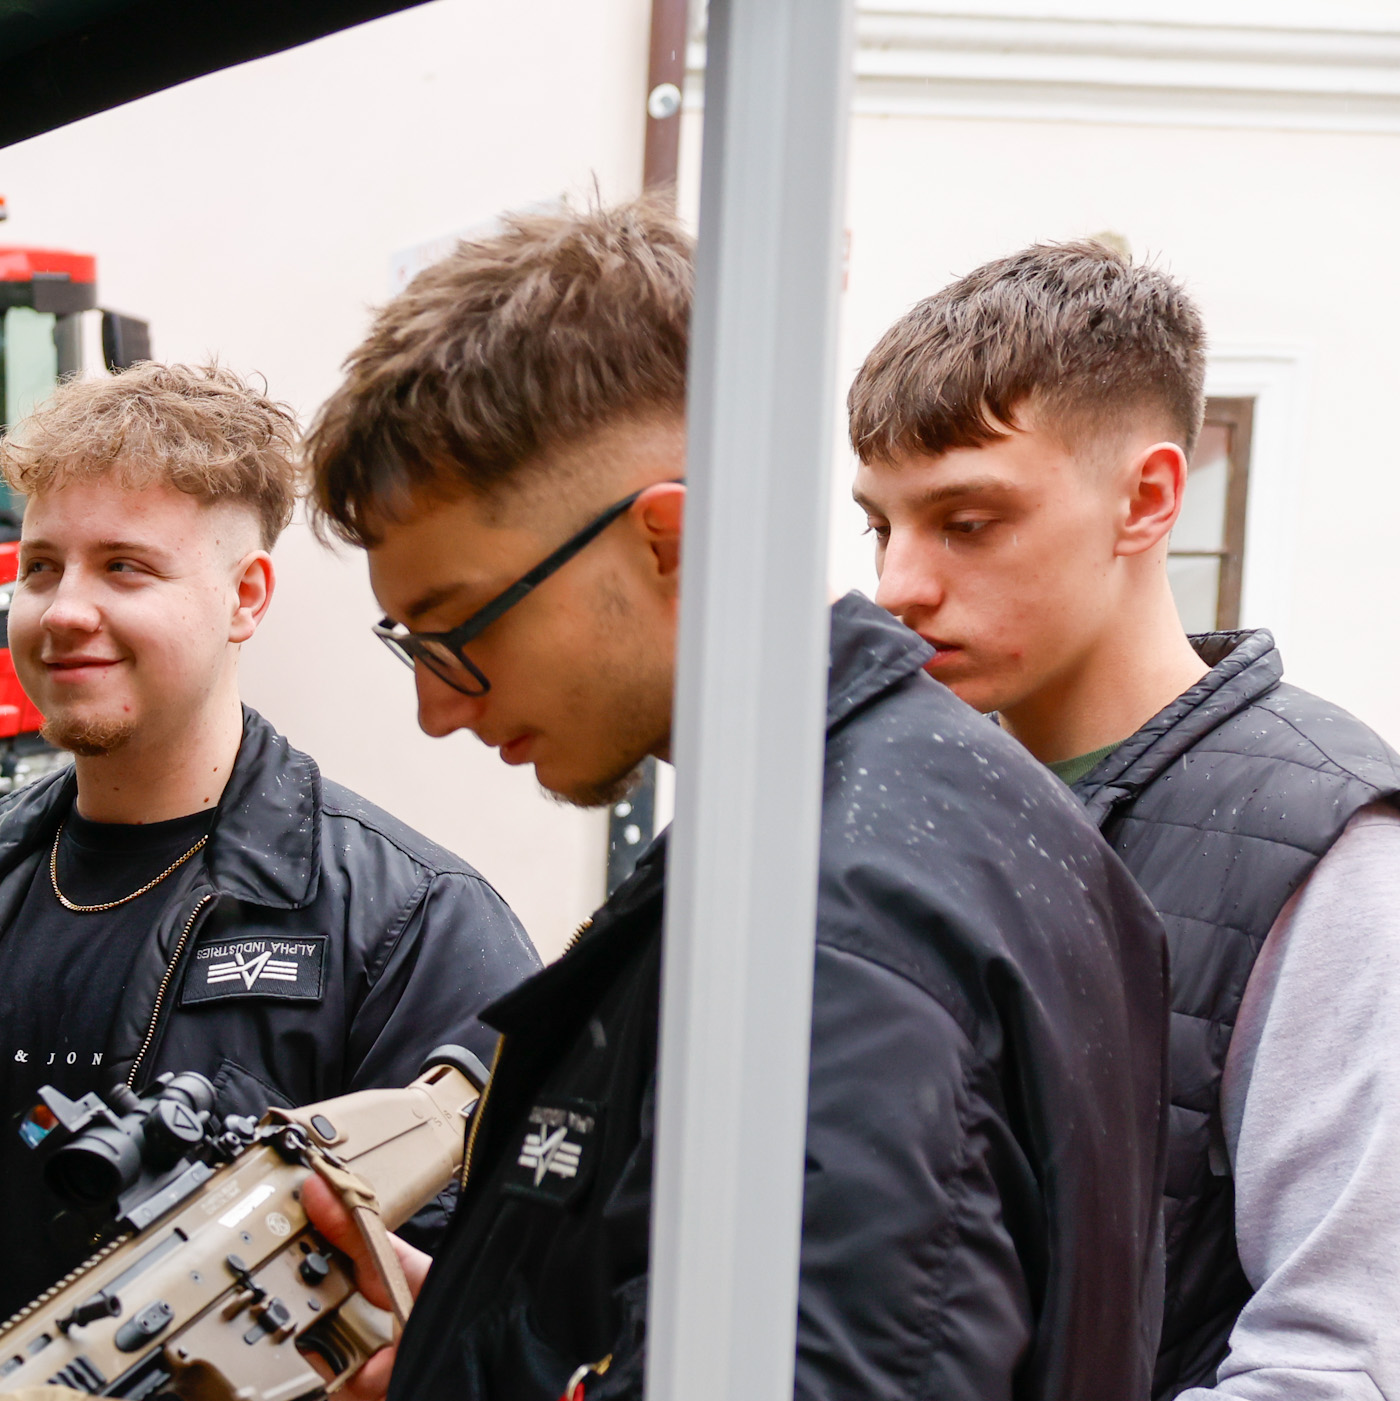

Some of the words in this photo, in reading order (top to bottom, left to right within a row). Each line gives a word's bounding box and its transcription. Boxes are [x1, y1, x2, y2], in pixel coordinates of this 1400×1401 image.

[196, 941, 266, 960] INDUSTRIES
[270, 942, 316, 957] ALPHA
[14, 1049, 29, 1063] &
